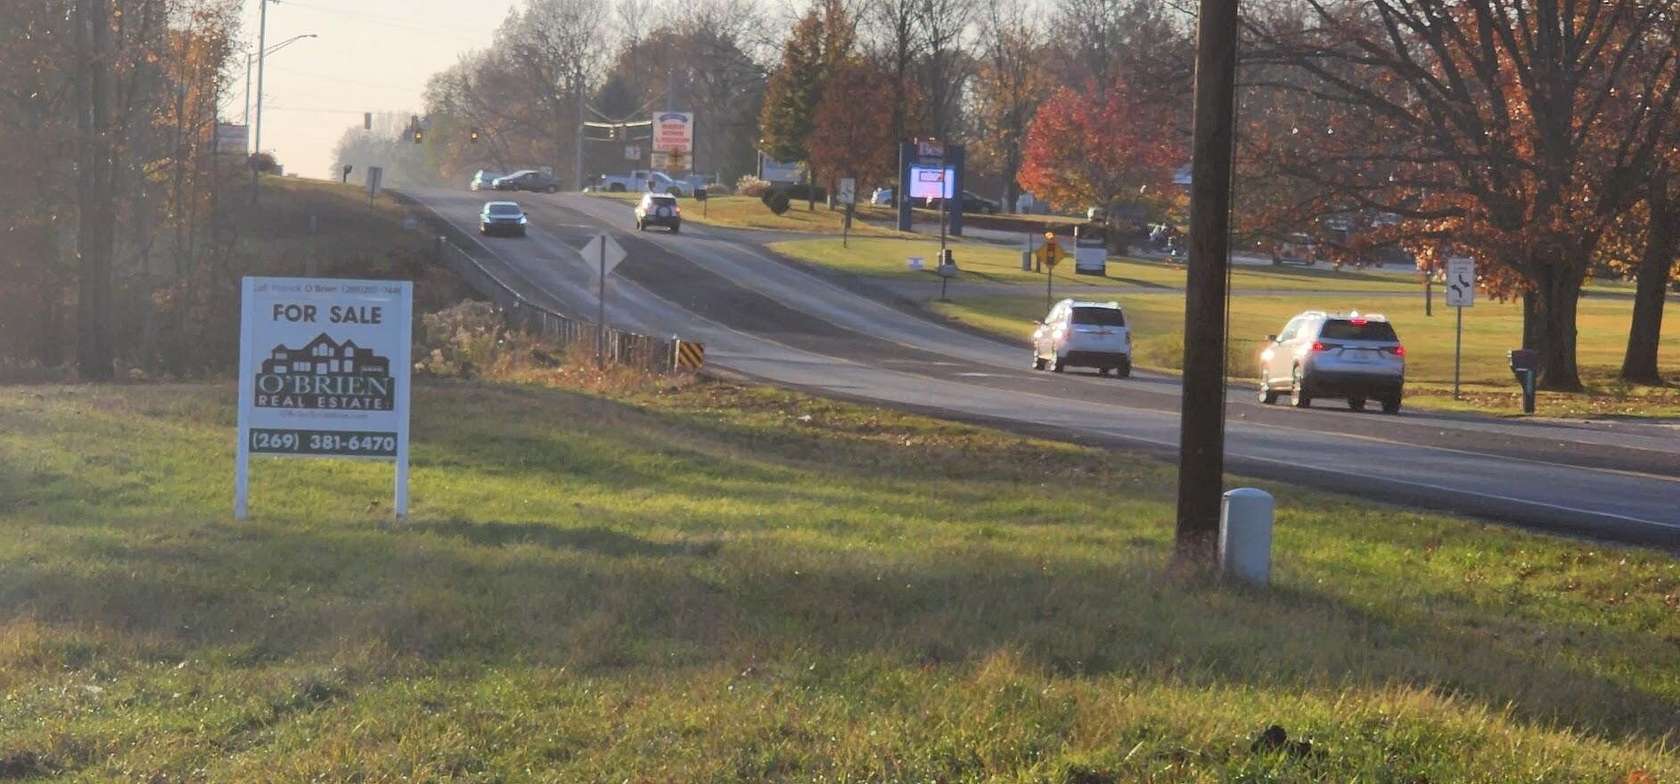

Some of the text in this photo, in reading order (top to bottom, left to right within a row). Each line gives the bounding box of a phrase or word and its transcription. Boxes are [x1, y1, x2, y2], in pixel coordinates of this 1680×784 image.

[273, 303, 382, 324] FOR SALE
[258, 374, 389, 396] O'BRIEN
[258, 395, 306, 407] REAL
[317, 396, 383, 409] ESTATE
[253, 432, 395, 451] (269) 381-6470
